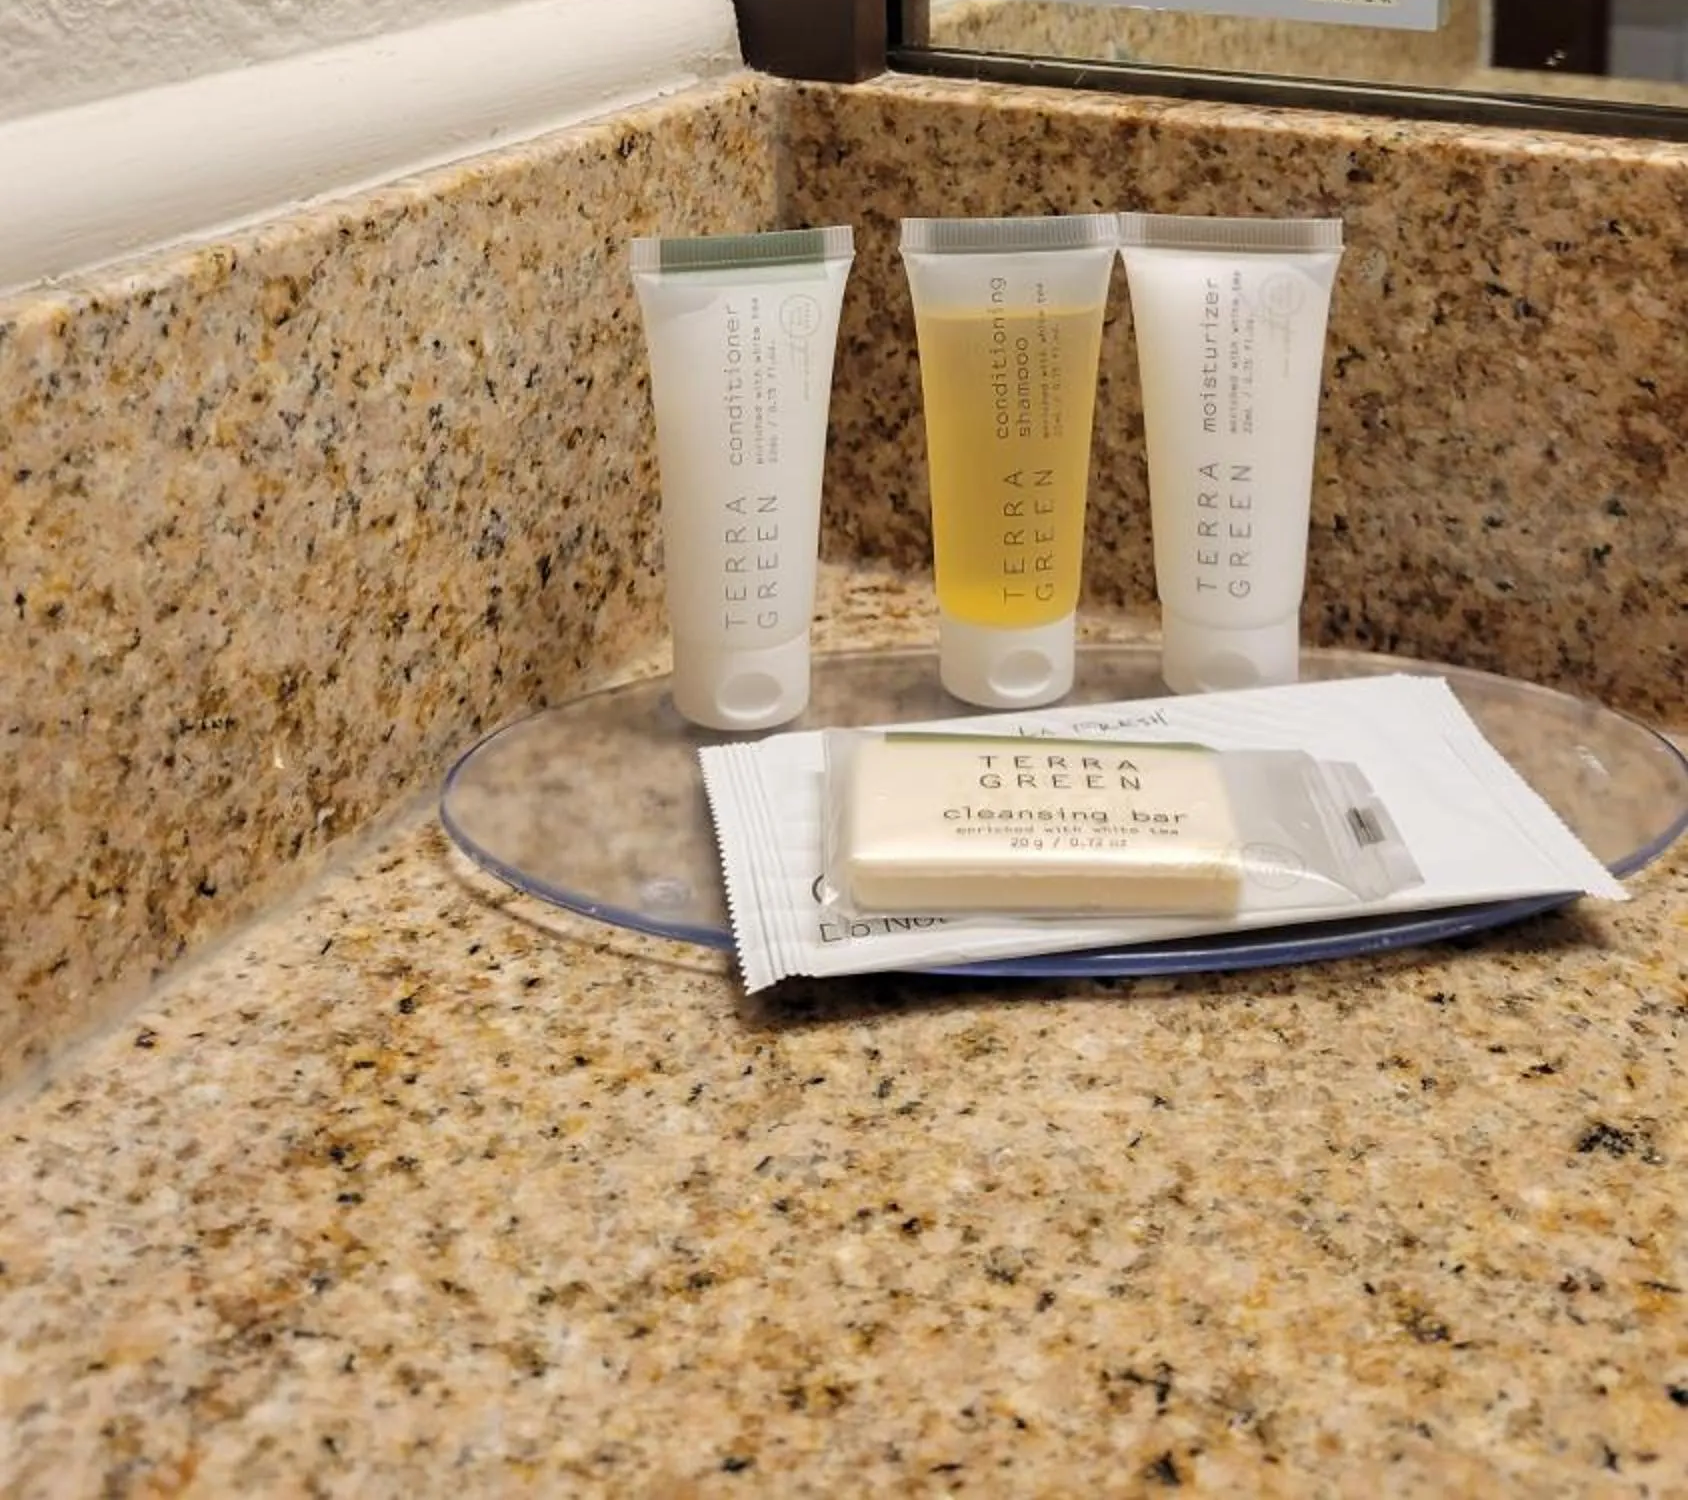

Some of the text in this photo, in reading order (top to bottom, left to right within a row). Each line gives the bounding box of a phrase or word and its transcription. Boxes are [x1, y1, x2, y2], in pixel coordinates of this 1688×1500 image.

[723, 303, 744, 467] conditioner
[752, 325, 763, 364] white
[753, 370, 764, 399] with
[989, 277, 1009, 439] conditioning
[1016, 336, 1031, 437] shampoo
[1200, 277, 1219, 434] moisturizer
[1230, 340, 1240, 370] with
[725, 496, 747, 631] TERRA
[757, 494, 779, 629] GREEN
[1003, 468, 1026, 605] TERRA
[1034, 468, 1054, 601] GREEN
[1196, 462, 1219, 593] TERRA
[1228, 464, 1252, 599] GREEN
[943, 806, 1189, 824] cleansing bar
[978, 755, 1140, 772] TERRA
[978, 773, 1142, 791] GREEN
[955, 825, 1180, 837] enriched with white tea
[1010, 836, 1029, 848] 20
[1034, 837, 1043, 850] g
